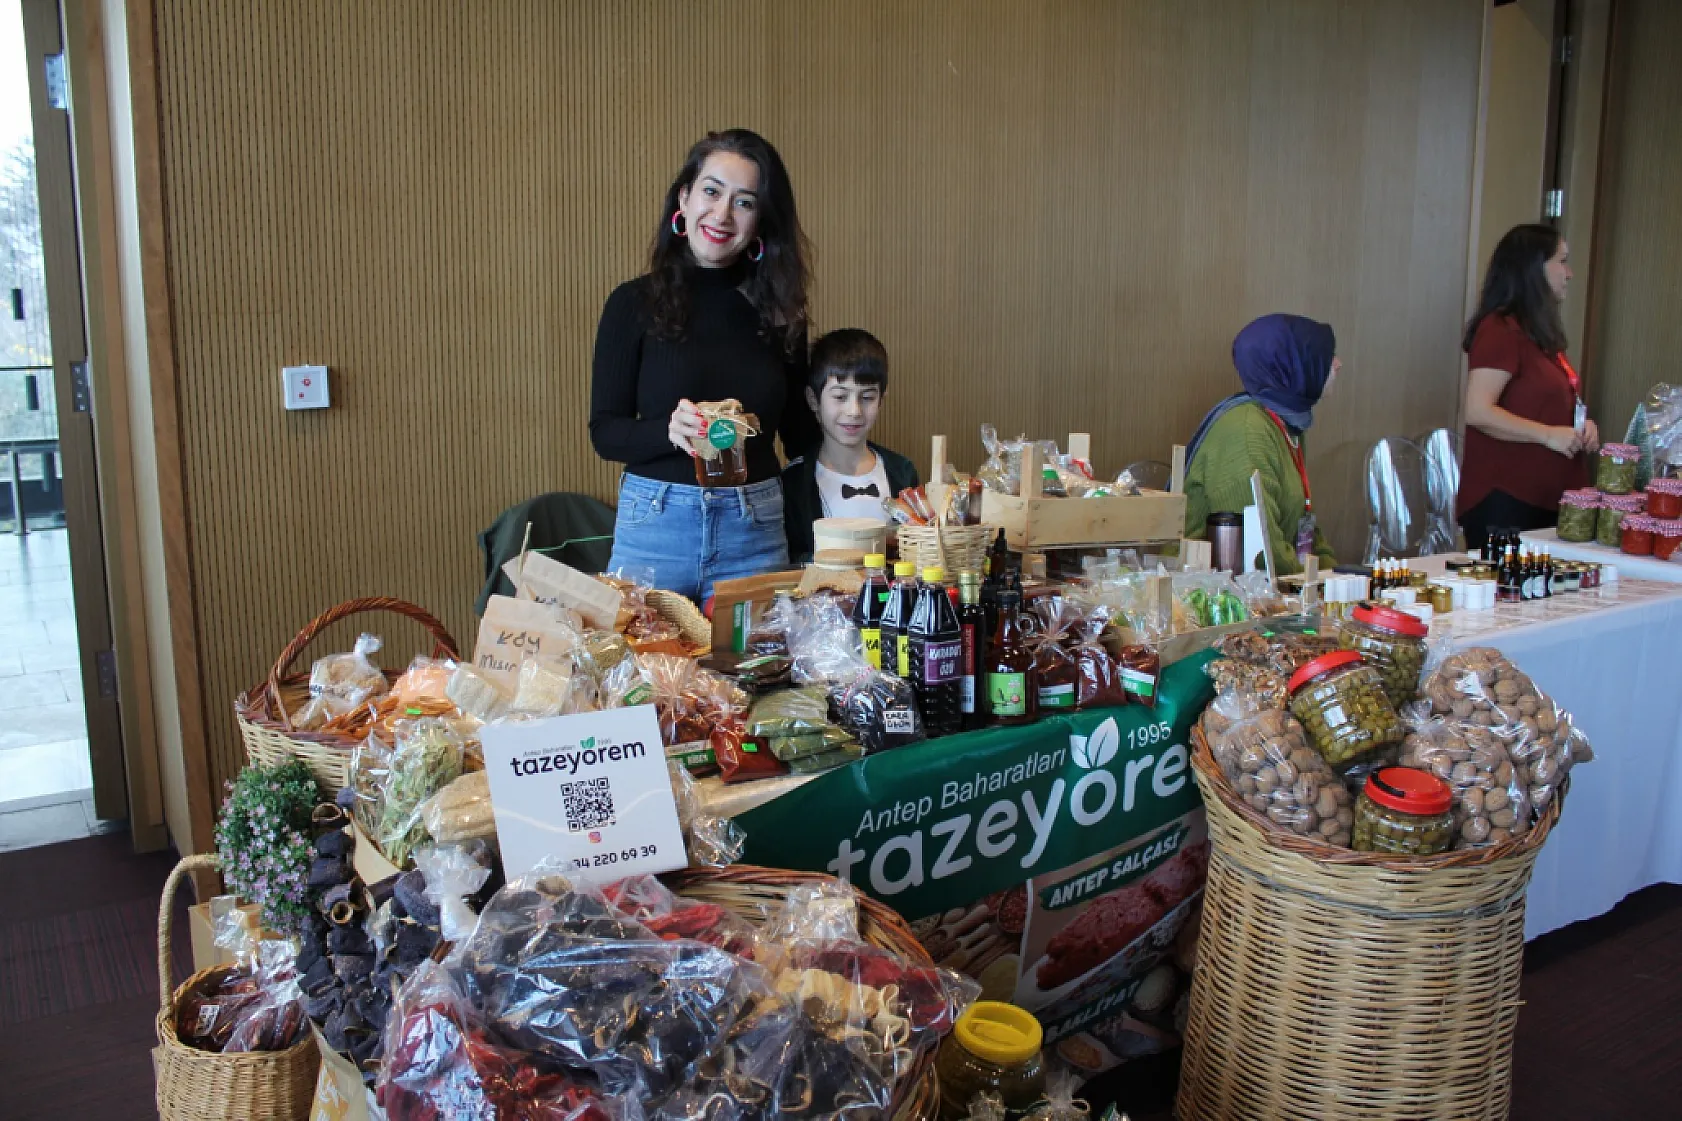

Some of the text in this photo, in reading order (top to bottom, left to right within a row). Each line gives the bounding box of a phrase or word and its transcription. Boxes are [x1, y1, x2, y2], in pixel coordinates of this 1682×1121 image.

[854, 720, 1172, 838] Antep Baharatları 1995
[593, 852, 618, 867] 220
[621, 847, 637, 861] 69
[640, 844, 657, 857] 39
[827, 743, 1197, 896] tazeyore
[1049, 867, 1109, 908] ANTEP
